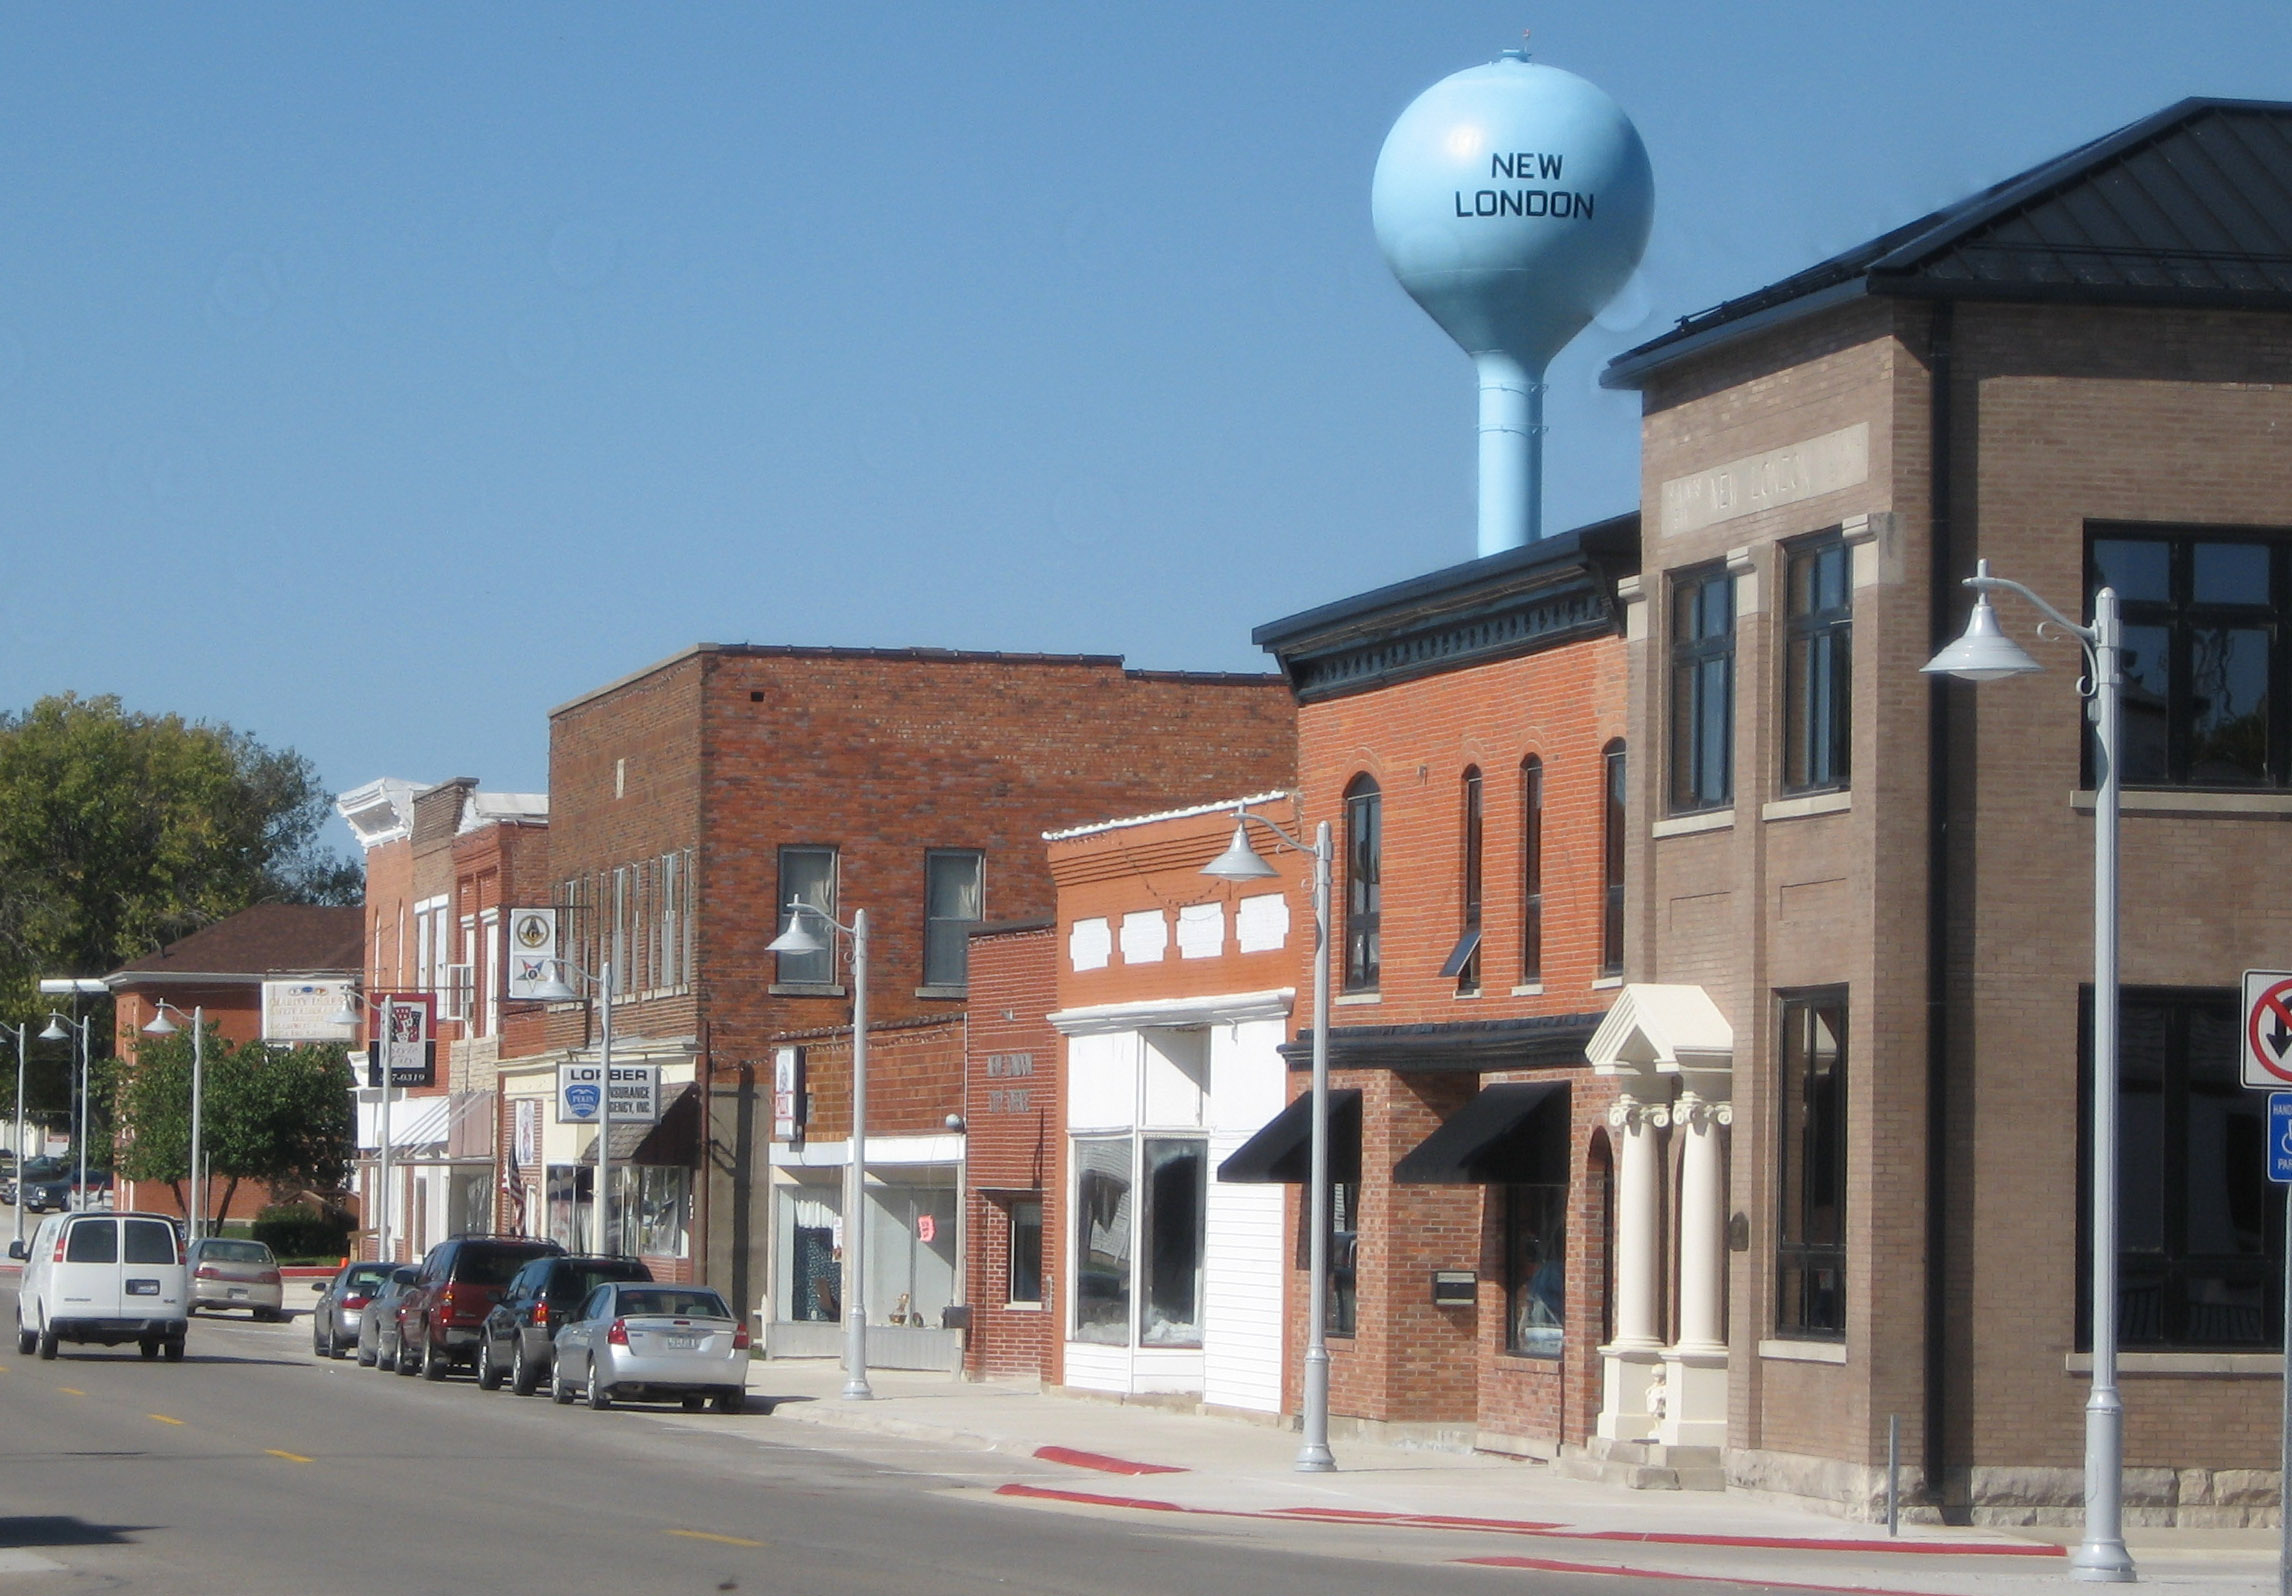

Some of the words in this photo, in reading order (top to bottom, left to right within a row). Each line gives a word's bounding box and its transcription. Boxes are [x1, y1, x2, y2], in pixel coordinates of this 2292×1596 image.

[1491, 152, 1563, 180] NEW
[1455, 189, 1594, 220] LONDON
[609, 1086, 650, 1099] SURANCE
[609, 1101, 633, 1115] GENCY,
